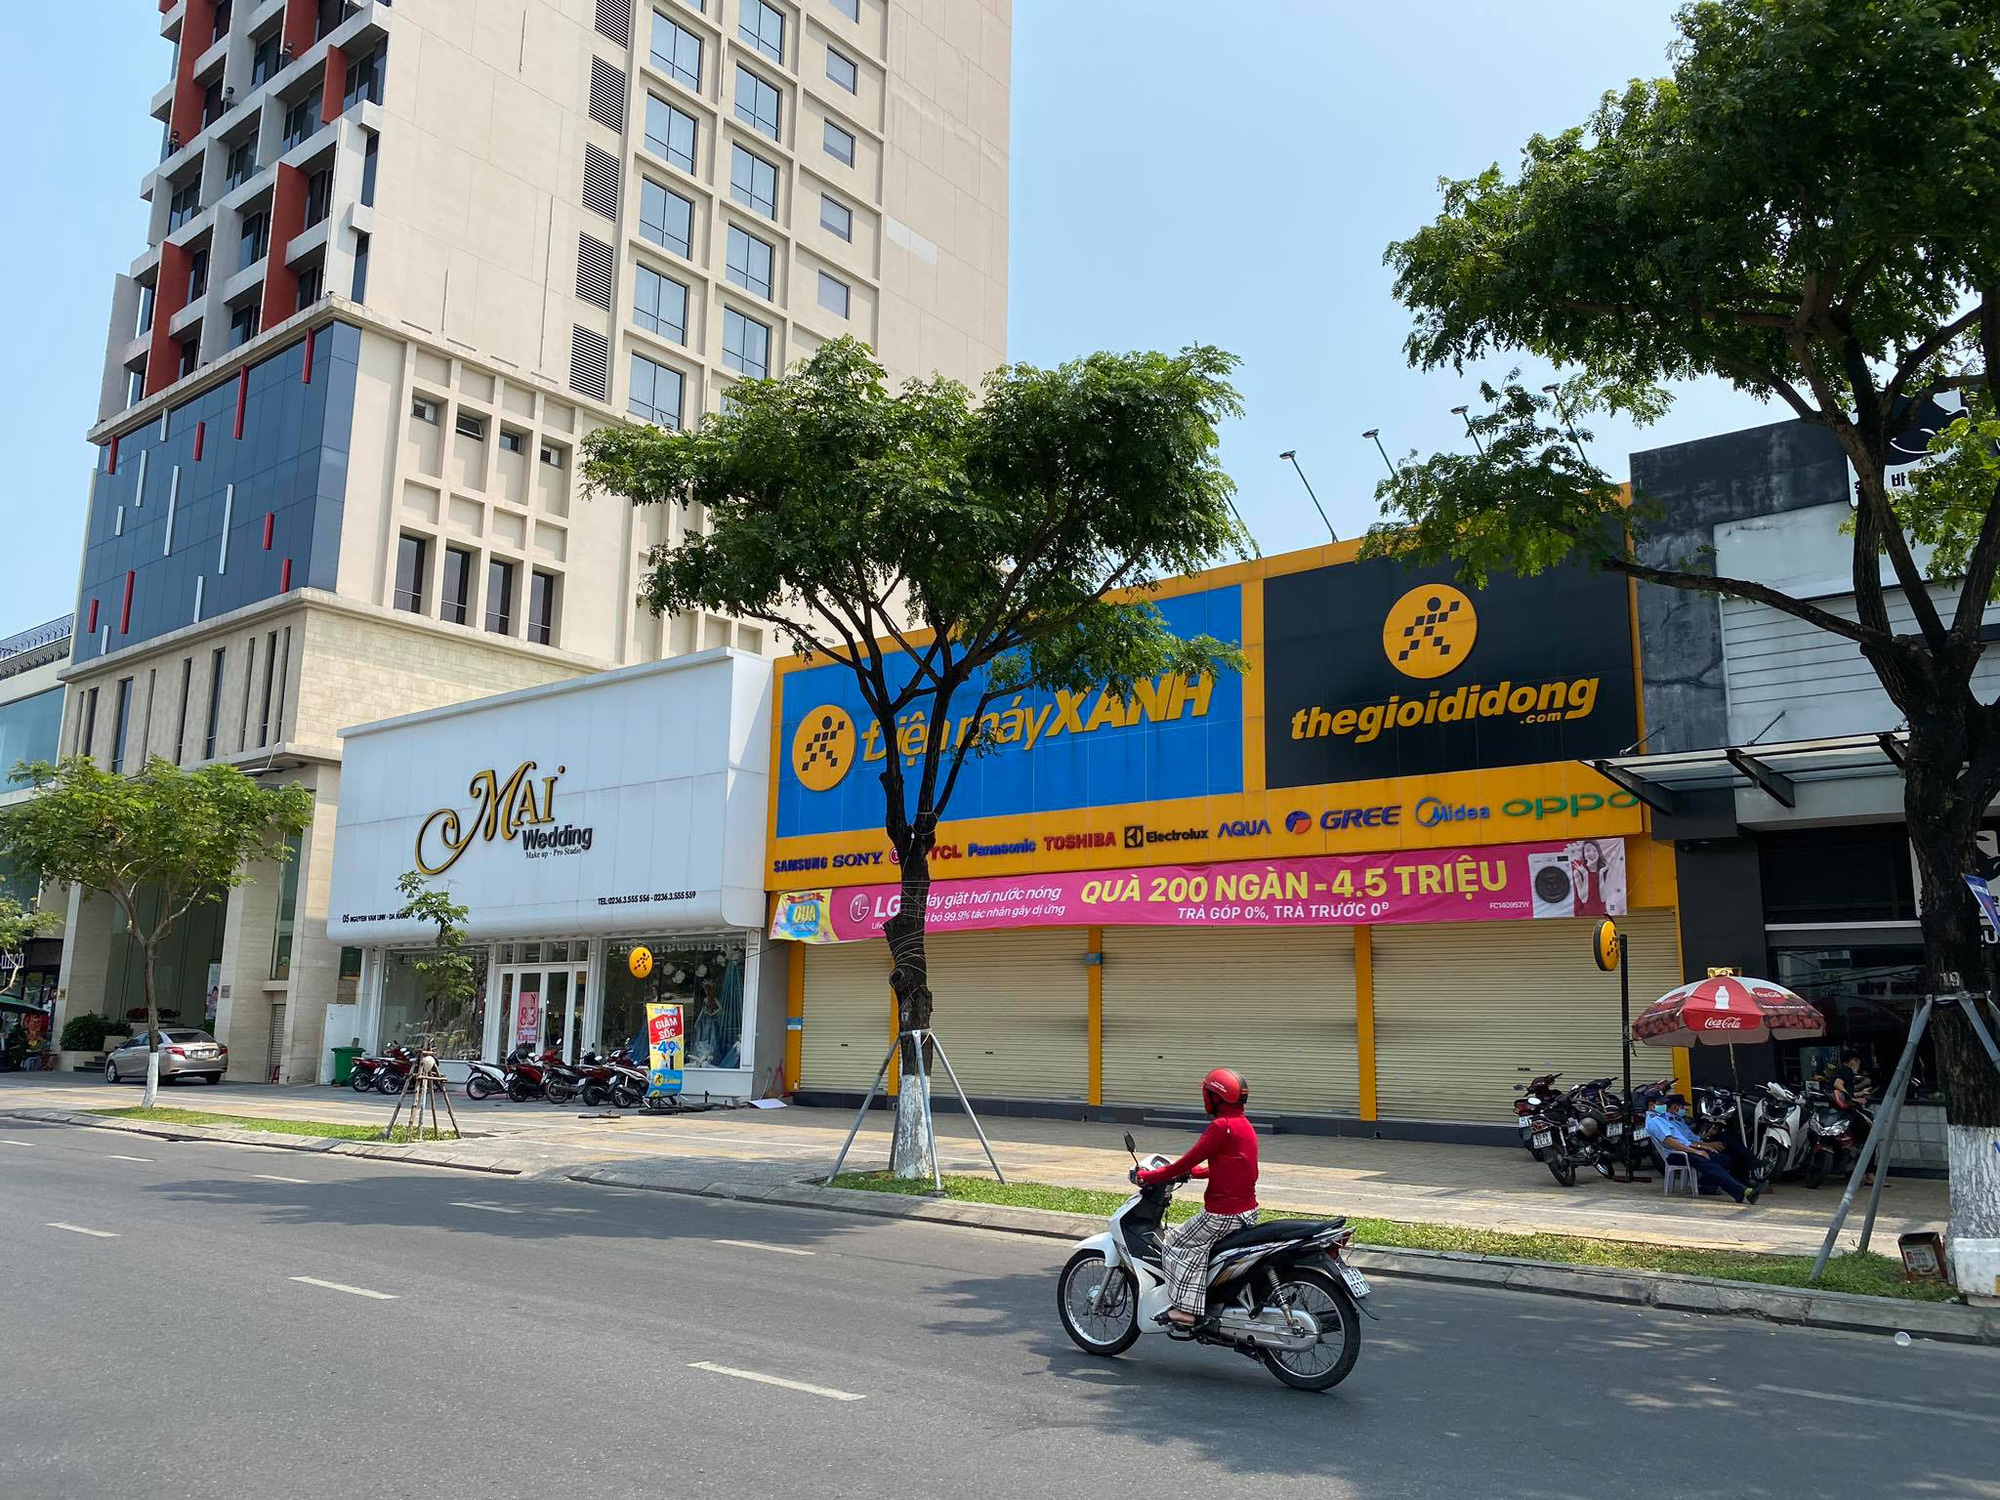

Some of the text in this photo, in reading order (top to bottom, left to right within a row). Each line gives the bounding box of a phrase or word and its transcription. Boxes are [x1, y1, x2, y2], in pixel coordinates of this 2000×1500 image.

[1291, 677, 1599, 744] thegioididong
[522, 824, 593, 850] Wedding
[773, 857, 828, 873] SAMSUNG
[832, 852, 881, 868] SONY
[930, 845, 962, 860] TCL
[968, 839, 1036, 857] Panasonic
[1044, 832, 1117, 851] TOSHIBA
[1146, 828, 1208, 843] Electrolux
[1218, 819, 1272, 838] AQUA
[1320, 805, 1402, 830] GREE
[1420, 798, 1491, 826] Midea
[1081, 874, 1141, 904] QUÀ
[1148, 876, 1209, 903] 200
[1215, 867, 1308, 902] NGÀN
[1394, 855, 1508, 901] TRIỆU
[874, 895, 902, 918] LG
[926, 893, 944, 909] áy
[991, 887, 1025, 902] nước
[1025, 885, 1062, 902] nóng
[986, 906, 1011, 918] nhân
[1210, 903, 1241, 920] GÓP
[1309, 901, 1366, 918] TRƯỚC
